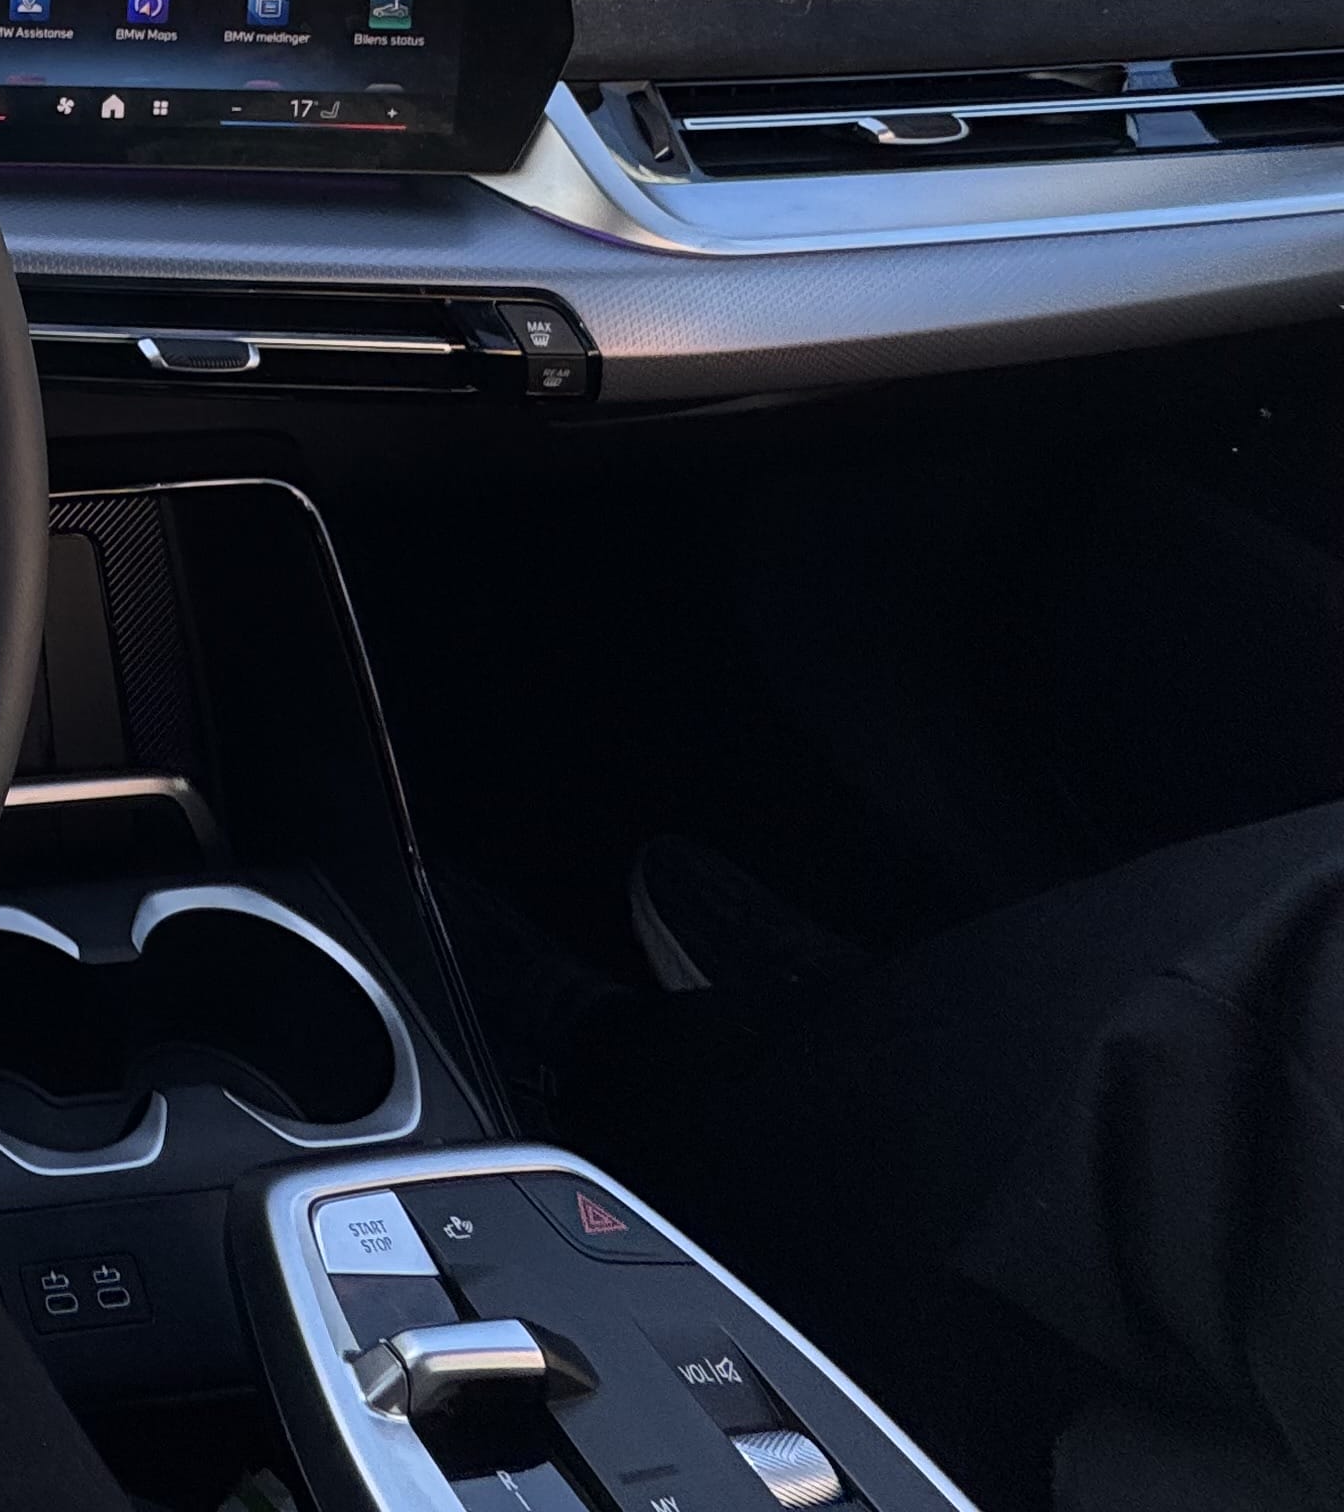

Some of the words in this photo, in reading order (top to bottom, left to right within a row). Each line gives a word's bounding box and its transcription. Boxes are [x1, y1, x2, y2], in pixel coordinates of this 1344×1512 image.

[15, 27, 74, 39] Assistanse
[115, 28, 145, 40] BMW
[147, 29, 178, 43] Maps
[223, 30, 255, 43] BMW
[256, 31, 311, 45] meldinger
[353, 34, 388, 46] Bilens
[390, 36, 425, 47] status
[527, 321, 552, 334] MAX
[348, 1220, 388, 1237] START
[360, 1236, 392, 1253] STOP
